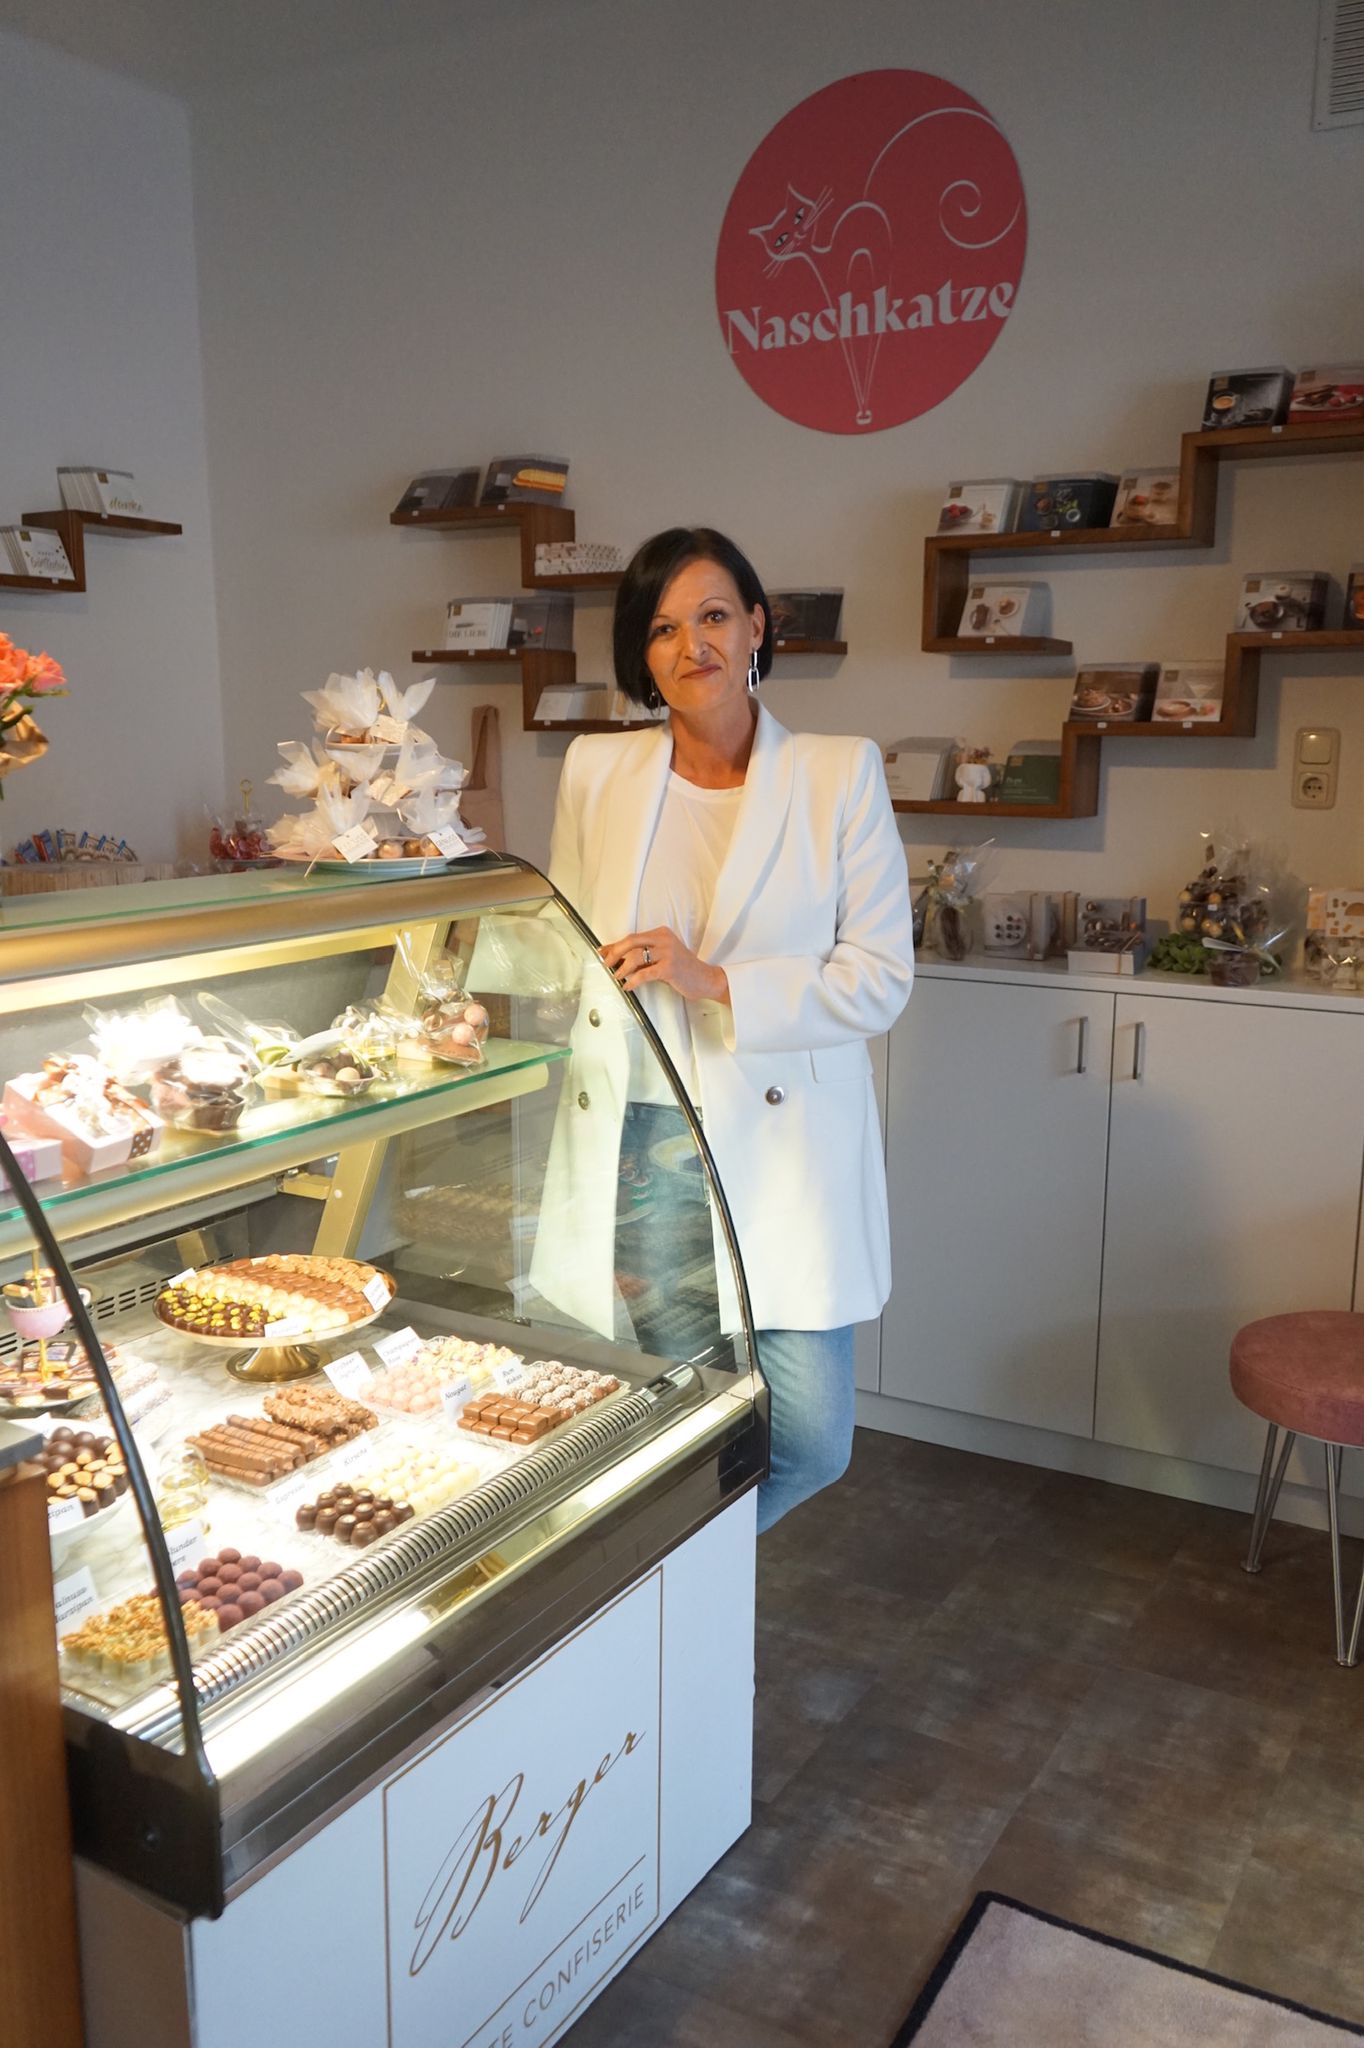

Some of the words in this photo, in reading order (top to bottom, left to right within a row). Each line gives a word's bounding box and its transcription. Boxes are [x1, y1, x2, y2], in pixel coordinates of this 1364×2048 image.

[724, 280, 1015, 353] Naschkatze
[444, 1383, 467, 1401] Nougat
[409, 1730, 647, 1977] Berger
[522, 1882, 645, 2029] CONFISERIE
